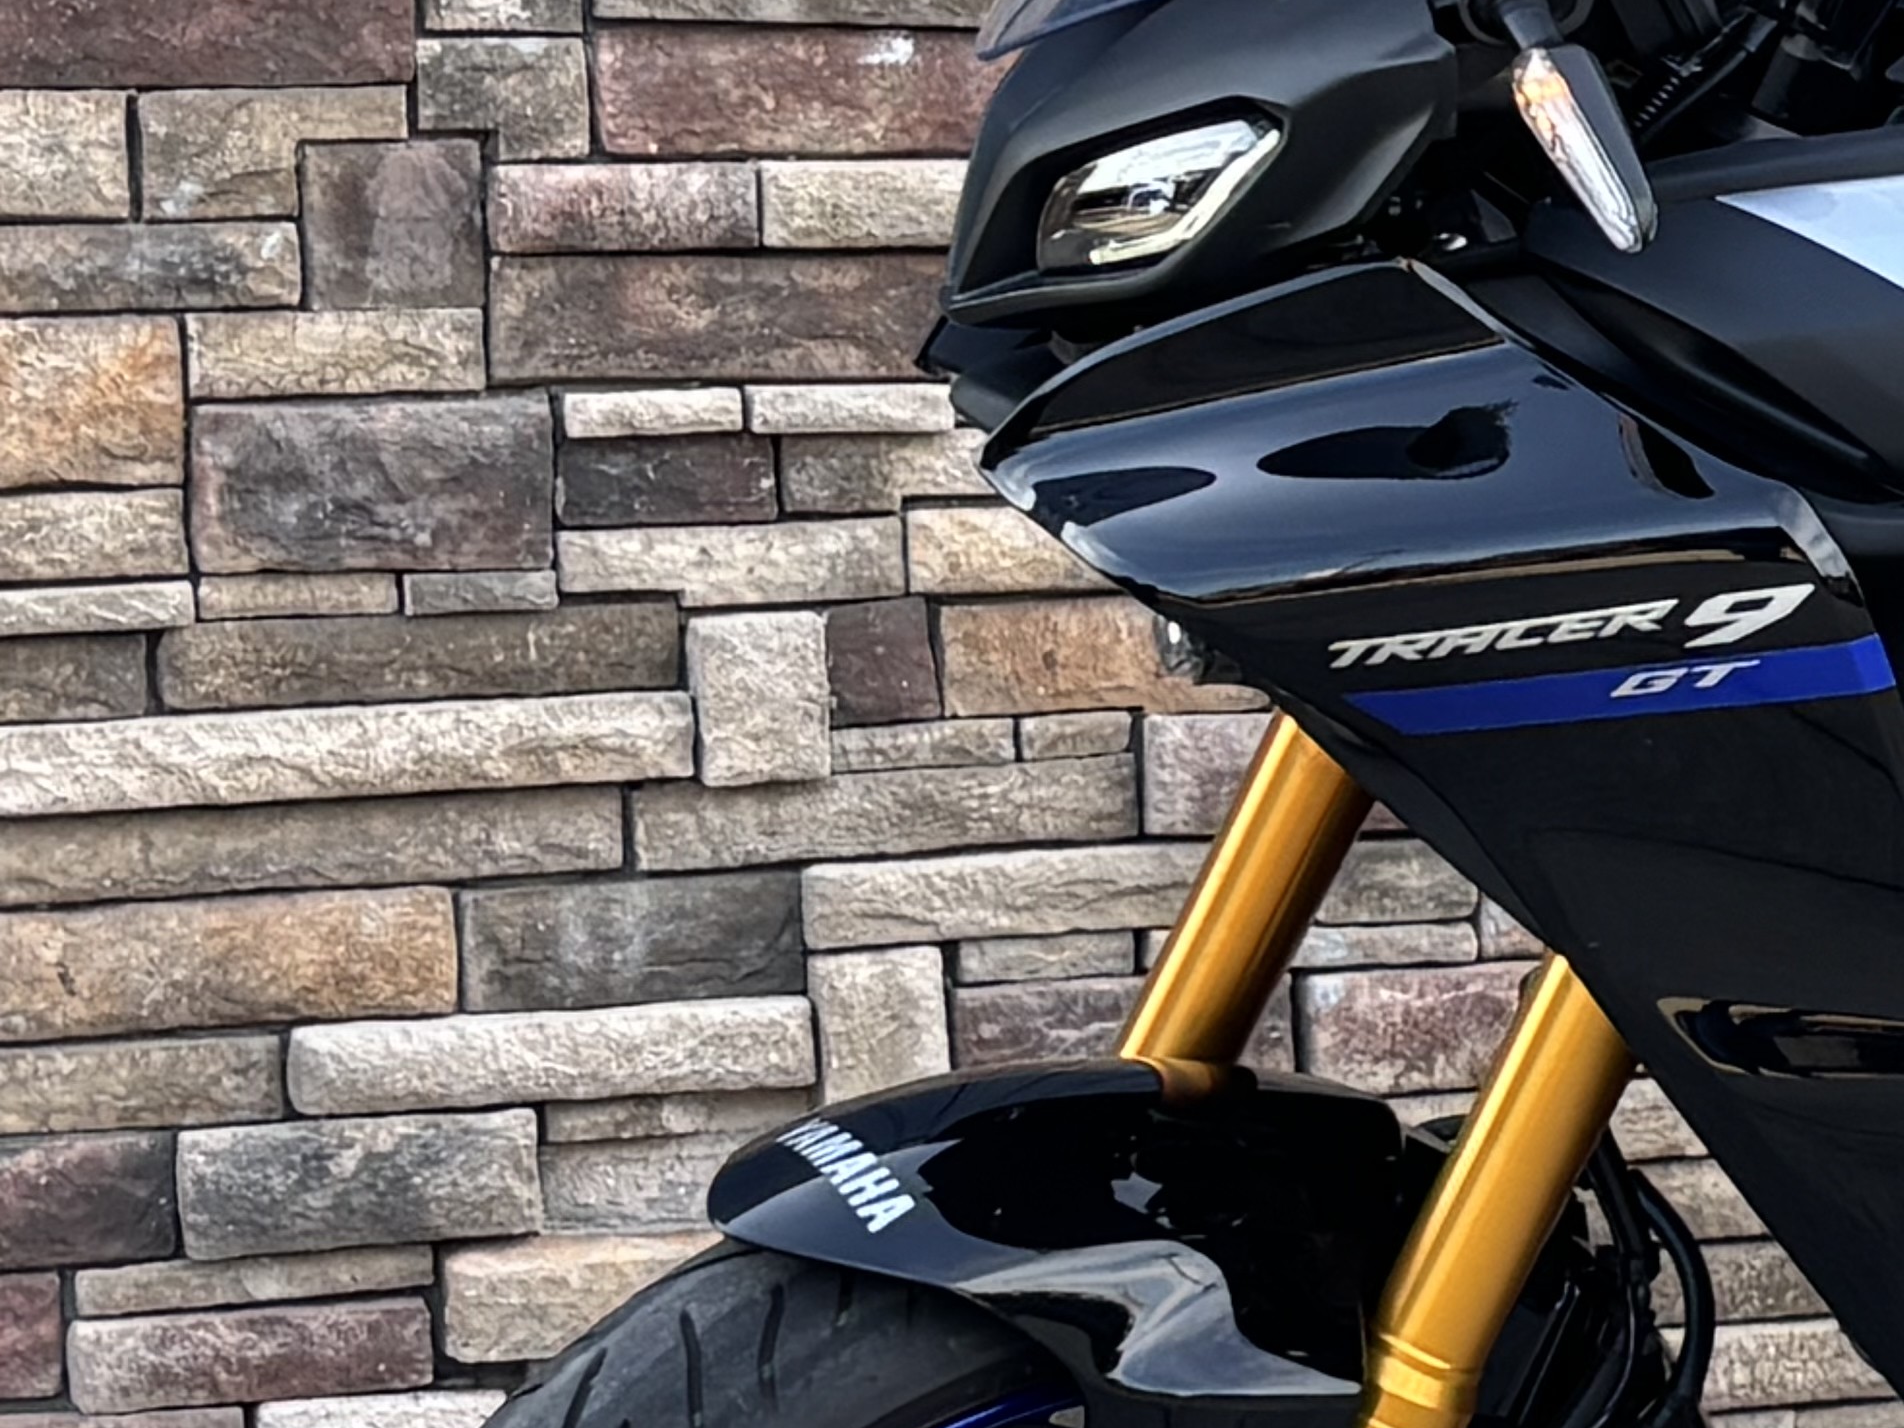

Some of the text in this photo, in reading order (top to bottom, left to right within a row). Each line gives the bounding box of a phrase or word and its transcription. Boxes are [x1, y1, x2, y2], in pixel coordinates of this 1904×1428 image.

[1328, 583, 1815, 668] TRACER 9
[1610, 659, 1761, 698] GT
[775, 1118, 915, 1234] YAMAHA
